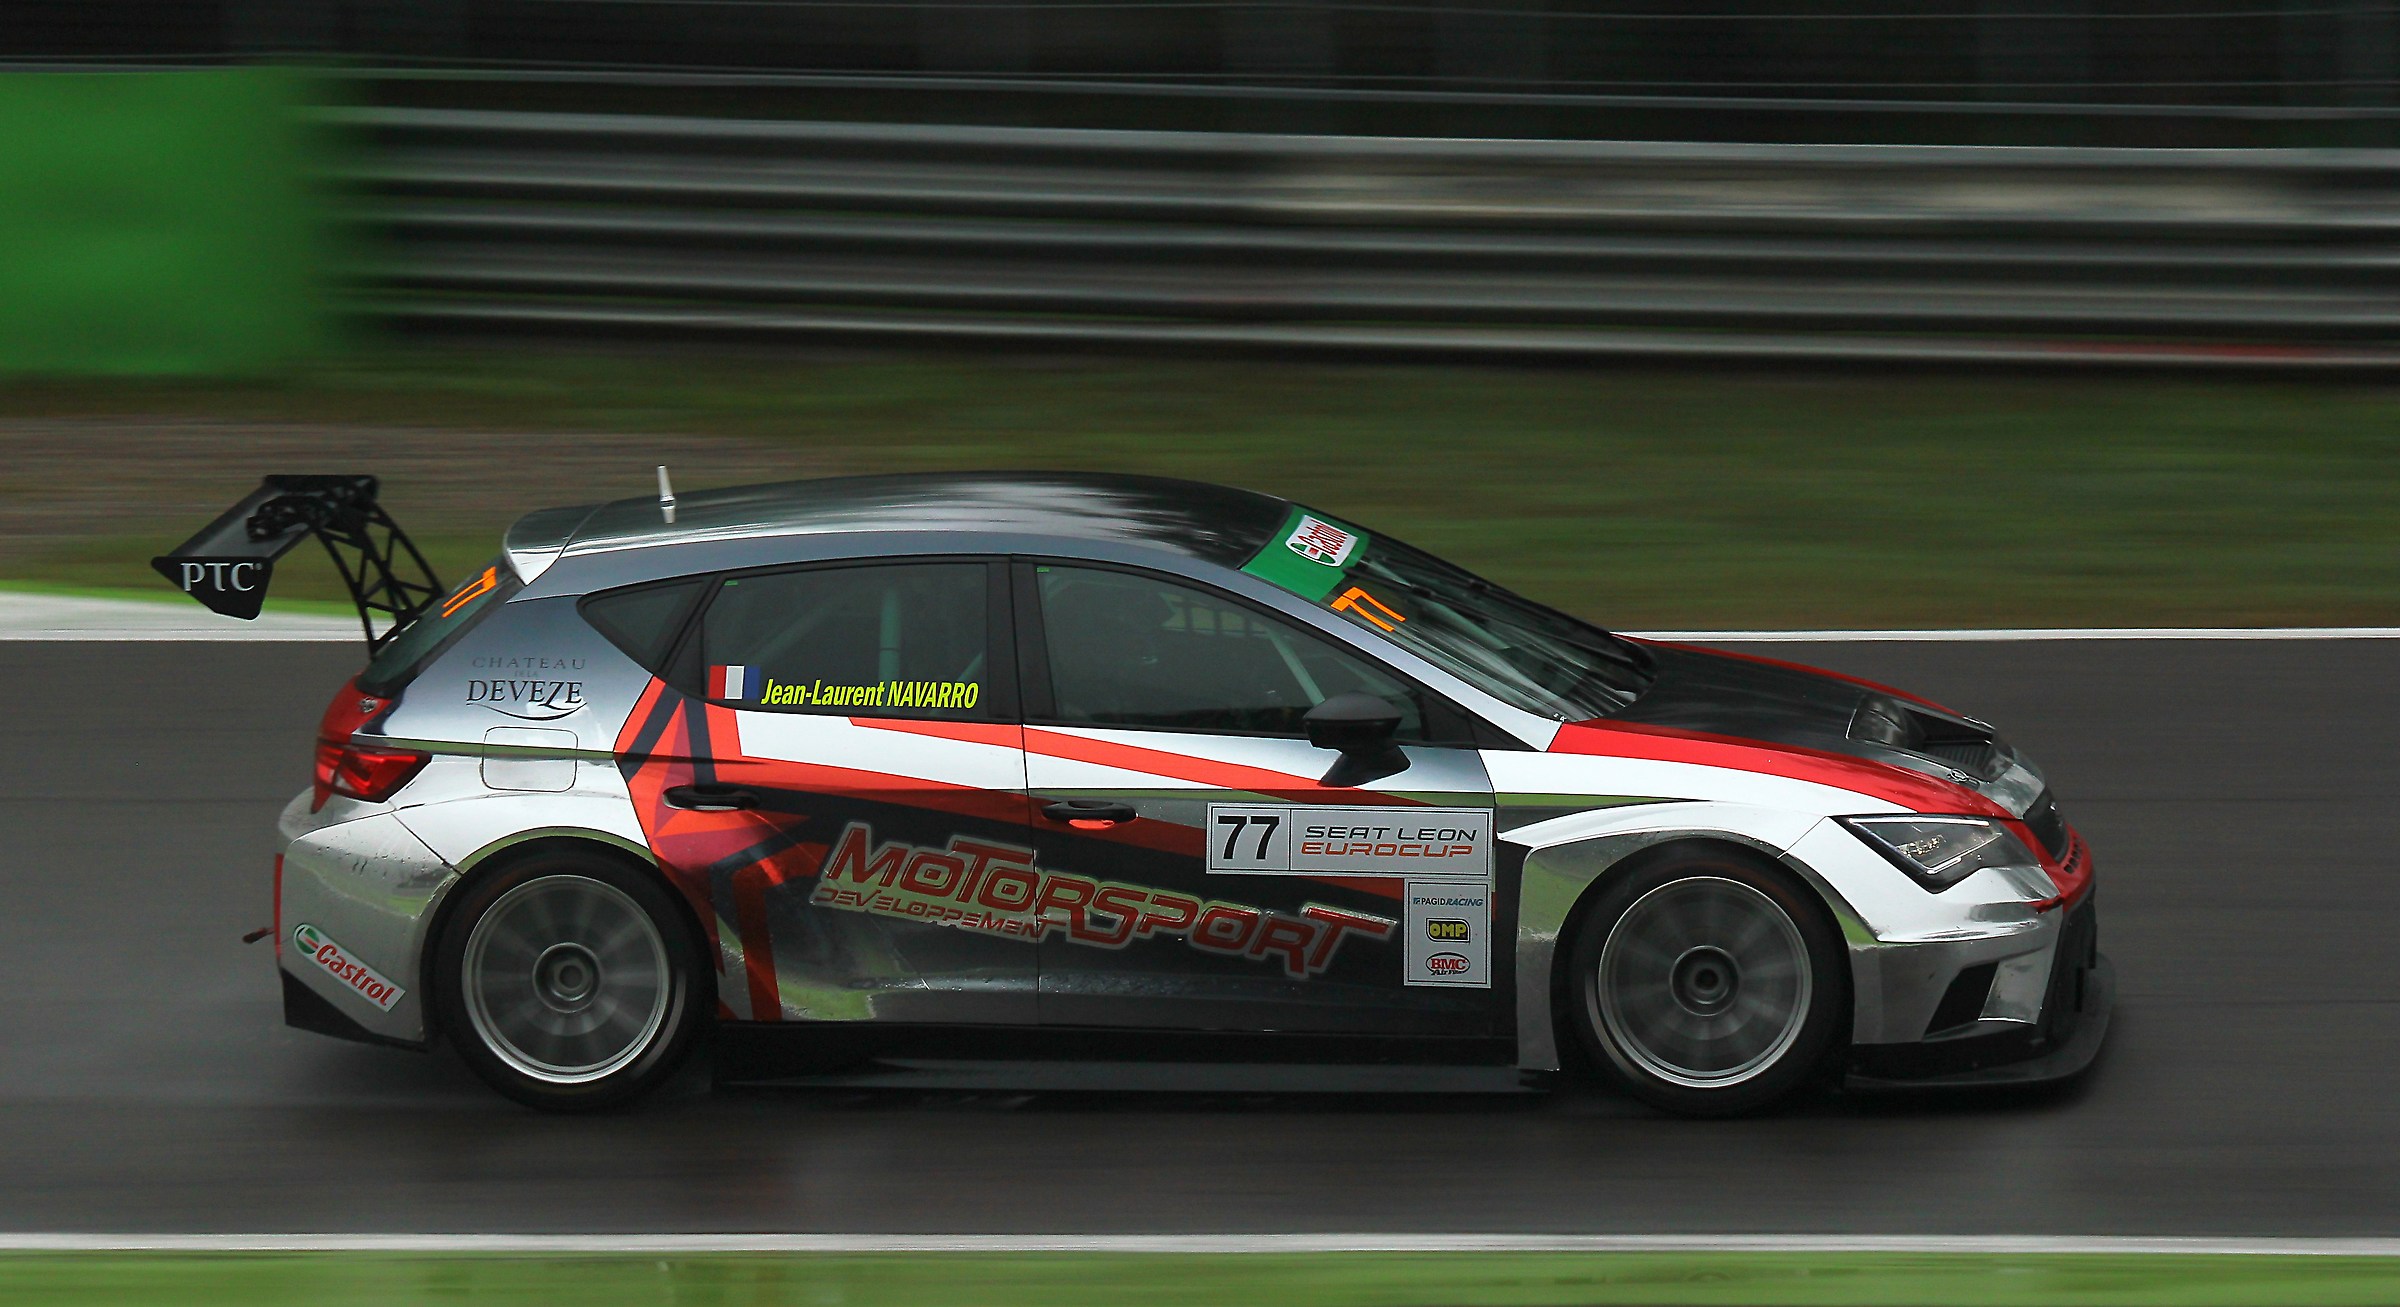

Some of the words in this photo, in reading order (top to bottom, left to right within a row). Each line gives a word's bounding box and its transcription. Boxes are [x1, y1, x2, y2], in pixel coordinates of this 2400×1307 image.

[1330, 586, 1406, 630] 77
[472, 656, 586, 670] CHATEAU
[466, 679, 582, 710] DEVEZE
[761, 678, 885, 707] Jean-Laurent
[886, 680, 979, 709] NAVARRO
[1217, 815, 1280, 860] 77
[1304, 825, 1391, 840] SEAT
[1397, 827, 1478, 842] LEON
[1301, 842, 1473, 858] EUROCUP
[825, 826, 1392, 974] MOTORSPORT
[1429, 922, 1467, 938] OMP
[315, 943, 396, 1007] Castrol
[1431, 957, 1468, 971] BMC
